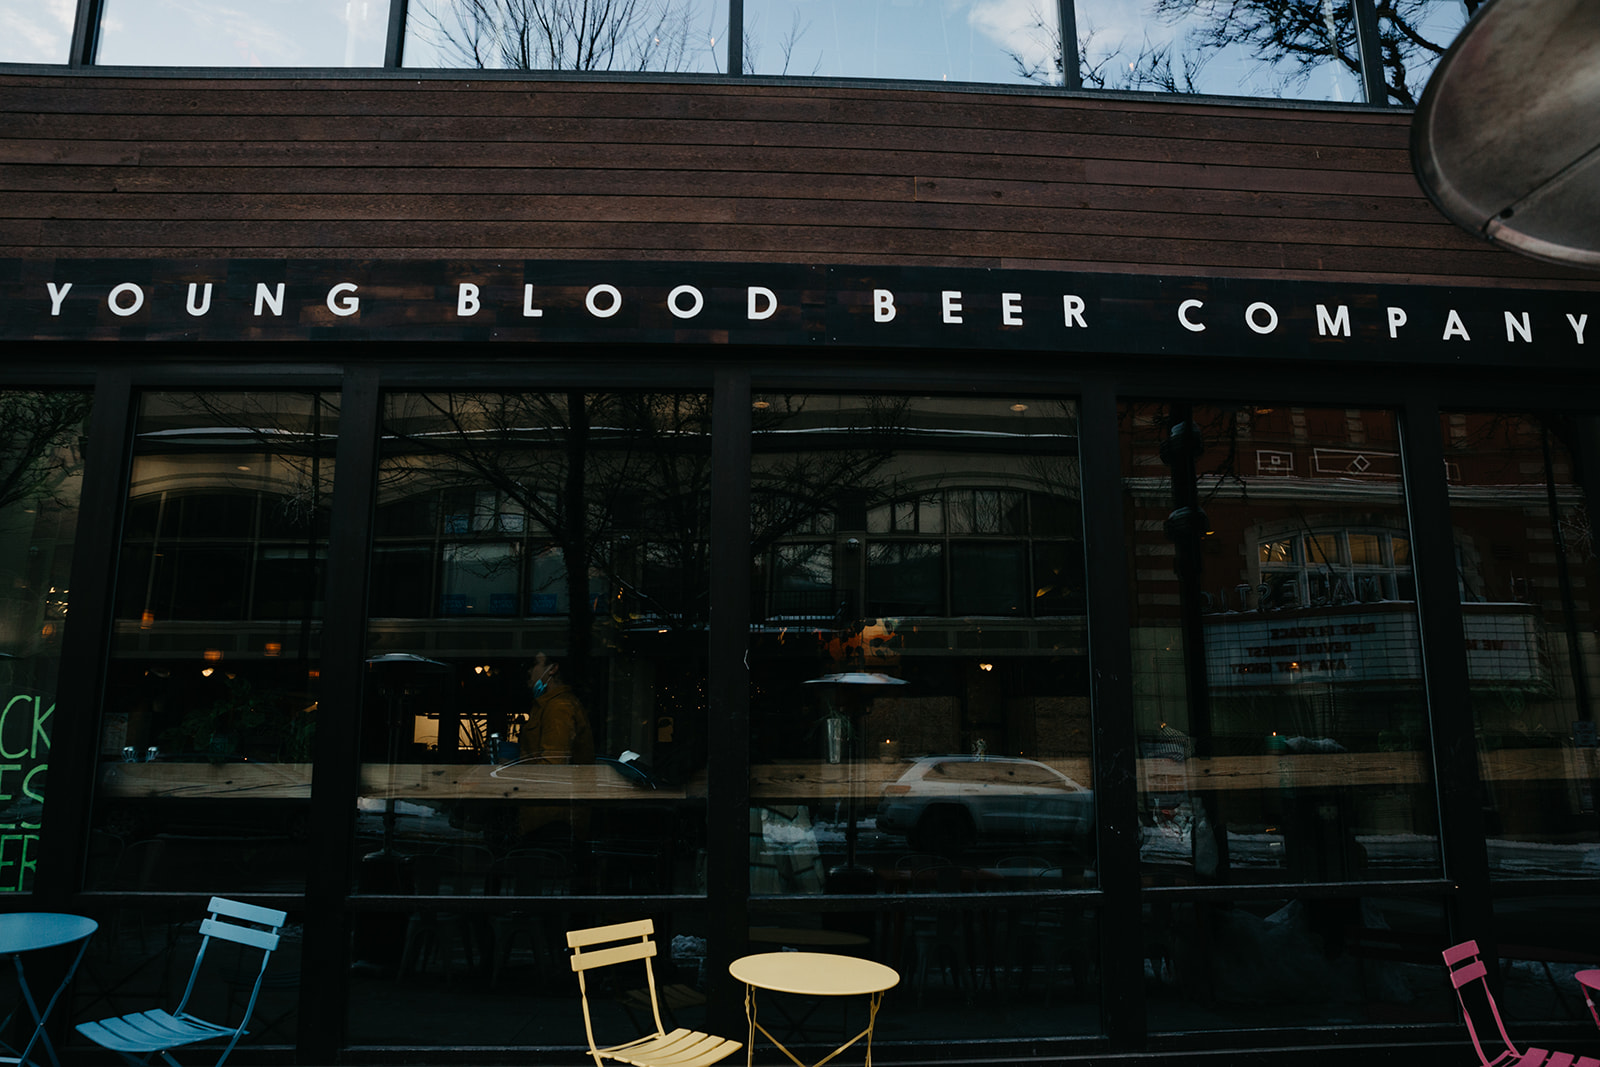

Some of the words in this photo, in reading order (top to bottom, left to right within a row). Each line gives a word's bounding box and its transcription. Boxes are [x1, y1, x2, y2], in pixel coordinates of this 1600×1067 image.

[46, 282, 361, 317] YOUNG
[457, 282, 778, 320] BLOOD
[873, 288, 1089, 328] BEER
[1177, 299, 1588, 345] COMPANY
